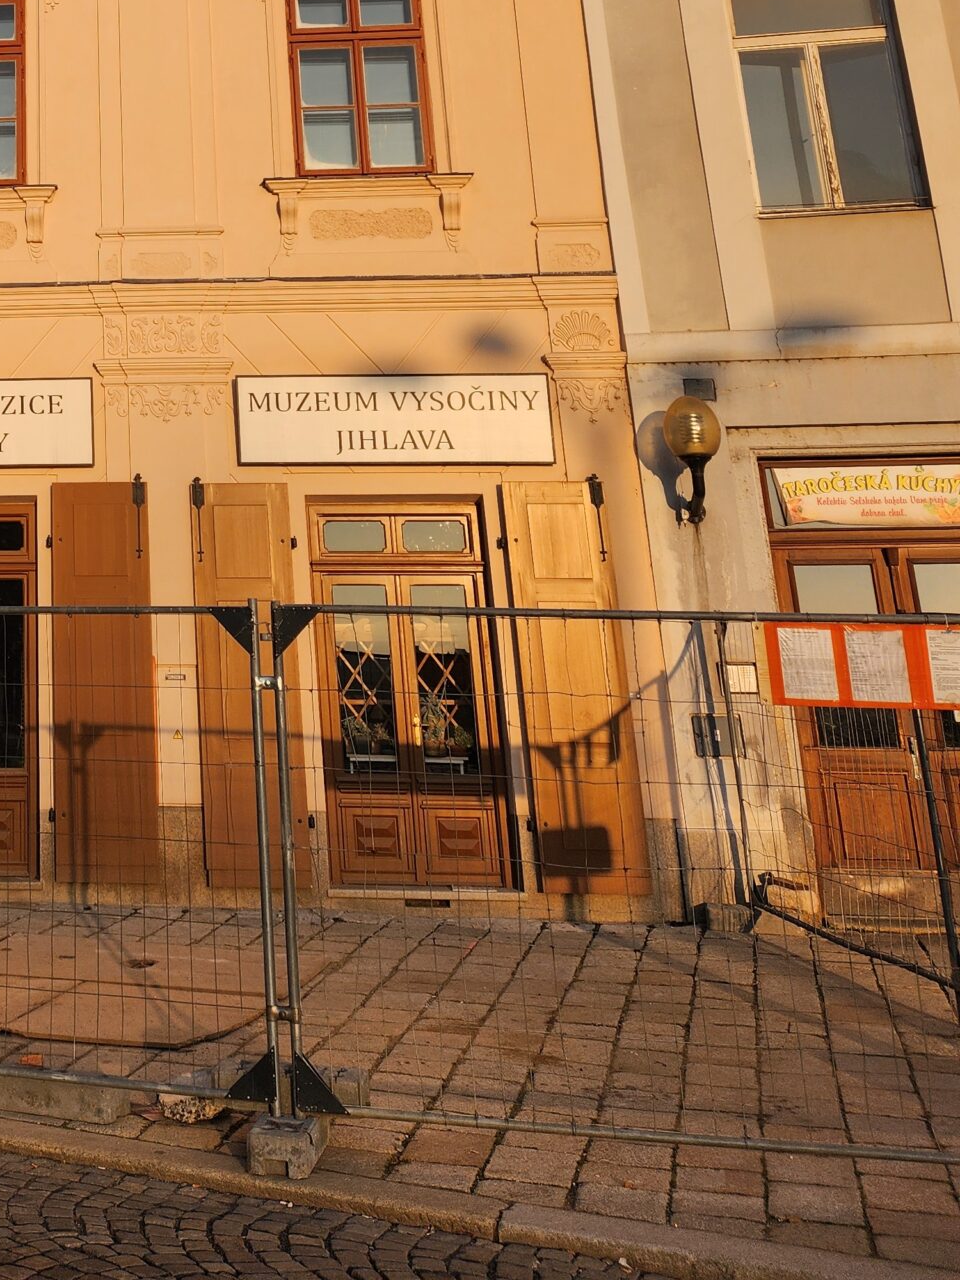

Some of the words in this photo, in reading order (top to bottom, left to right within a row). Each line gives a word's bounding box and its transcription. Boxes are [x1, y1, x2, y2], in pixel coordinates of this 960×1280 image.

[248, 391, 379, 412] MUZEUM
[389, 386, 539, 411] VYSOČINY
[336, 430, 455, 455] JIHLAVA
[782, 469, 892, 498] TAROČESKÁ
